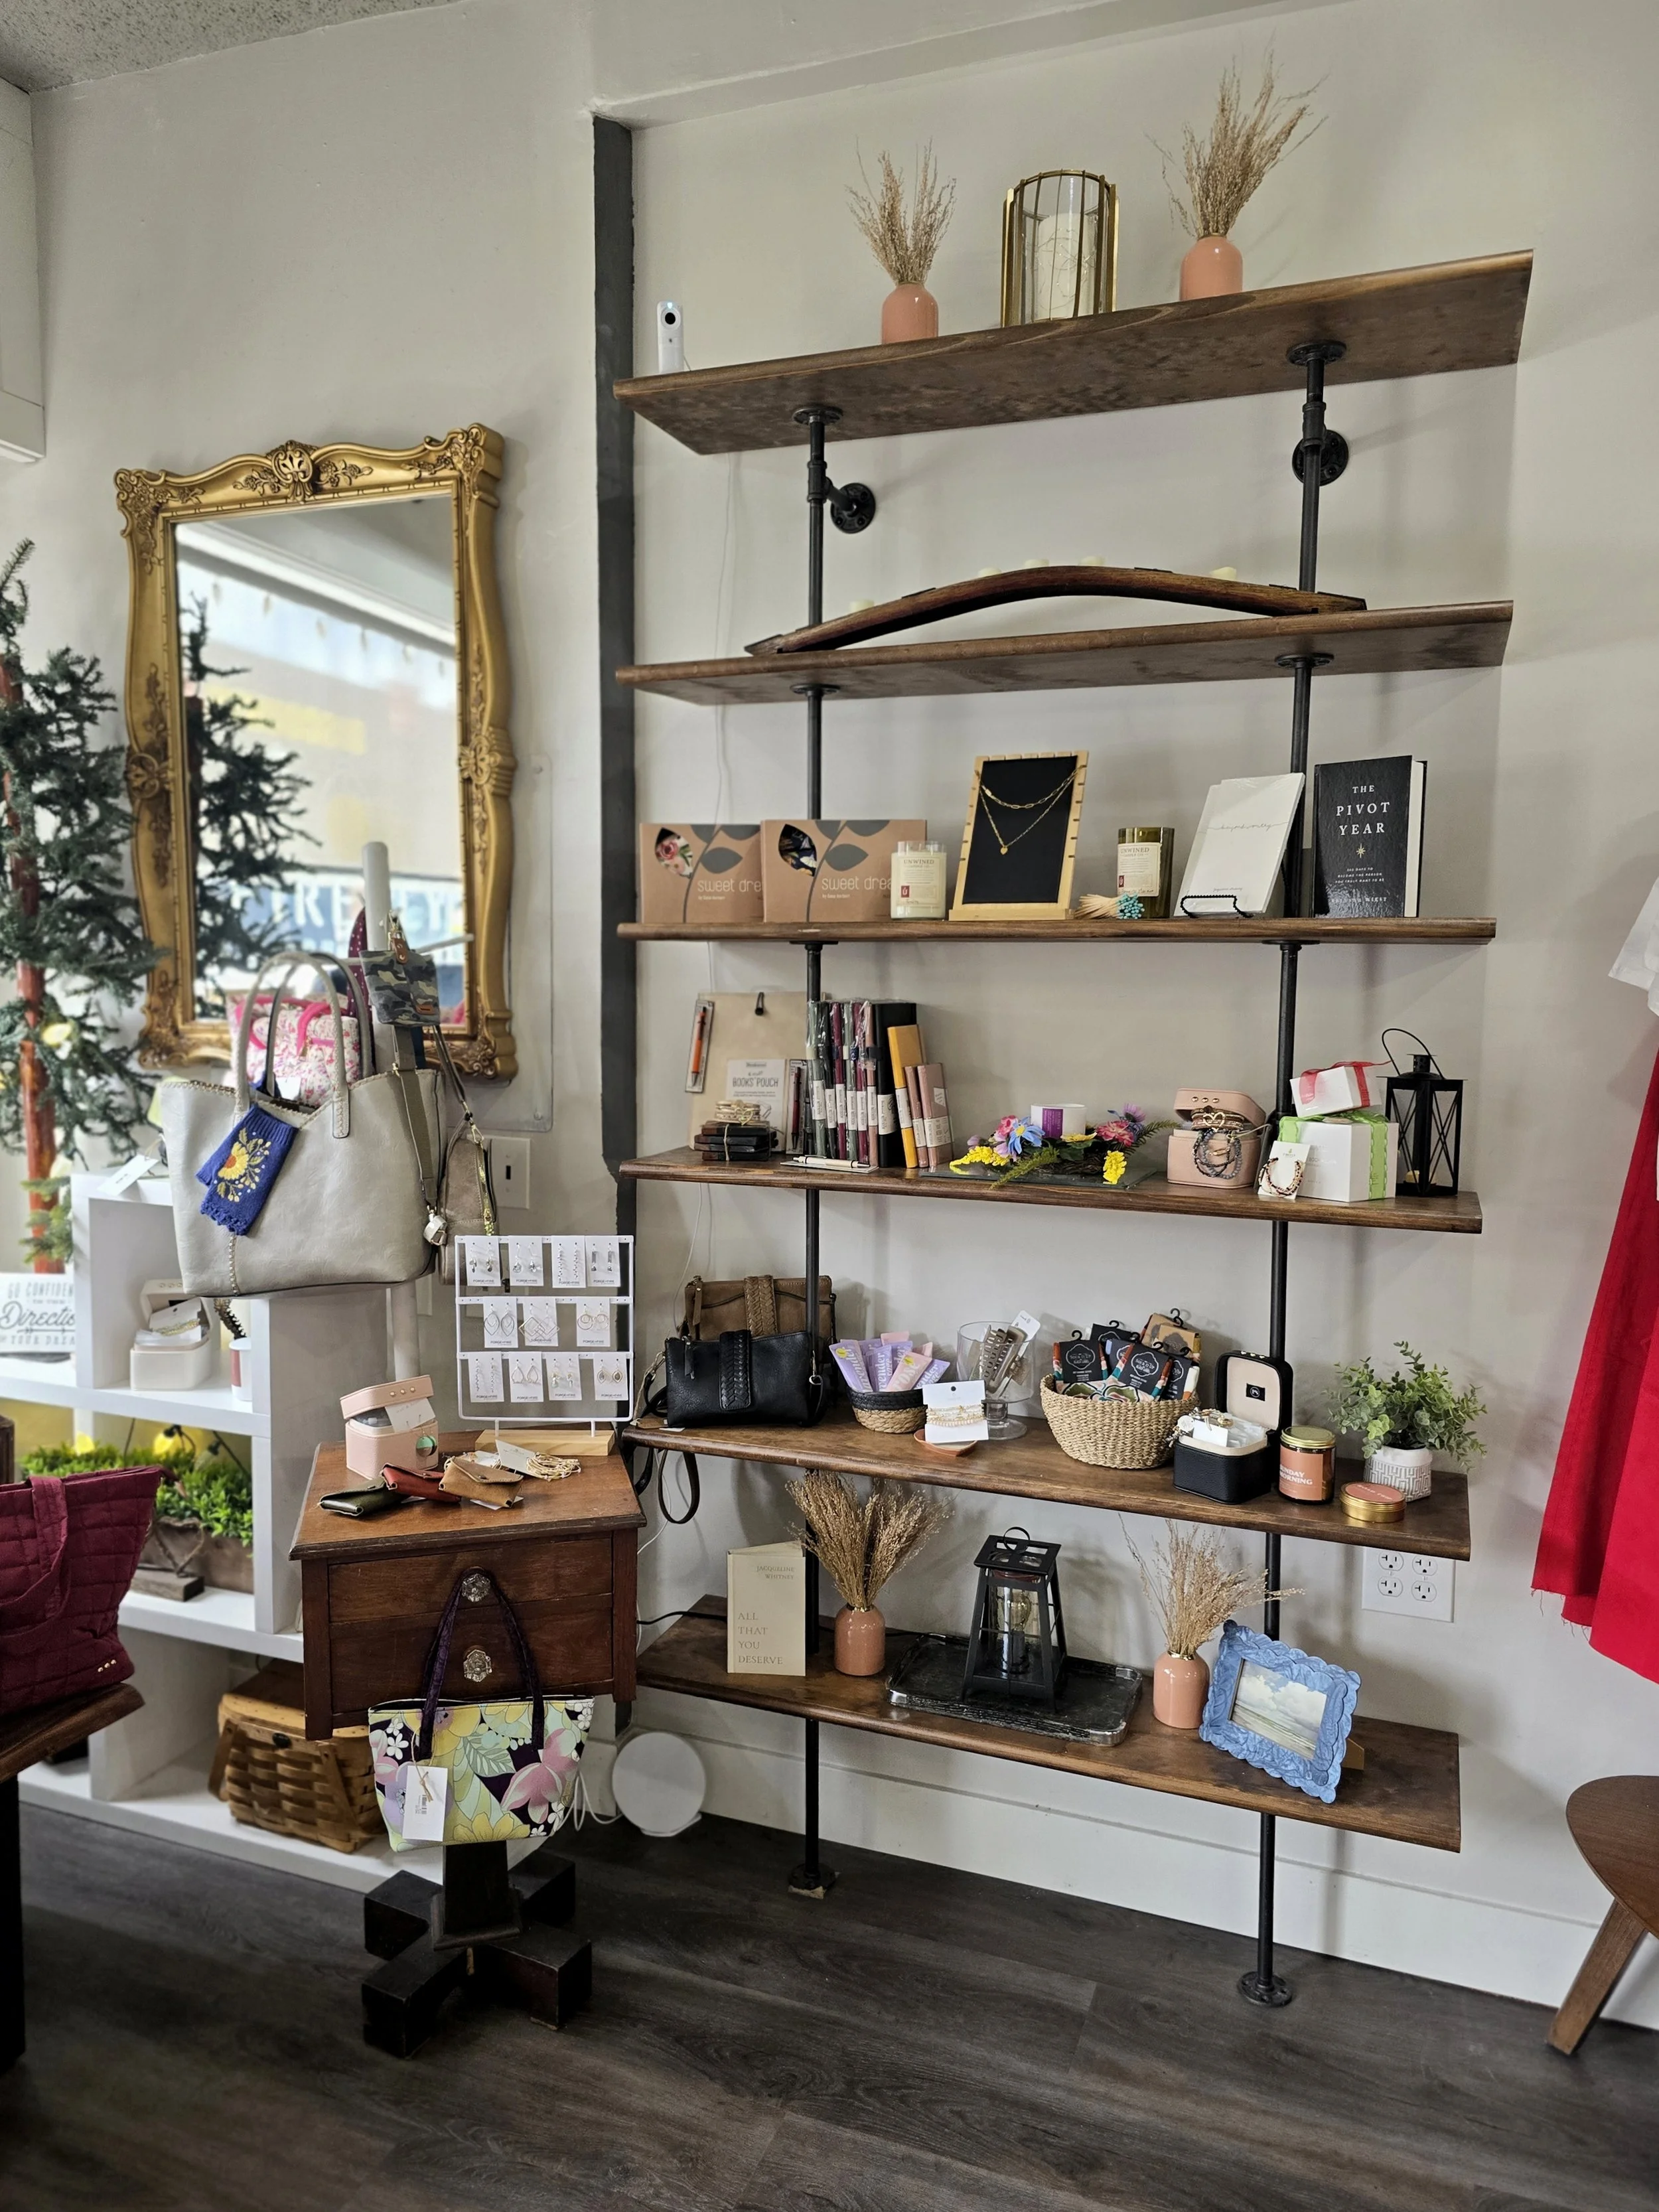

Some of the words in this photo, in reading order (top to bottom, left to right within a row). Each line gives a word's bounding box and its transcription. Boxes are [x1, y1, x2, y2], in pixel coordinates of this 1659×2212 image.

[1352, 785, 1375, 794] THE
[1336, 802, 1390, 816] PIVOT
[1339, 822, 1385, 836] YEAR
[697, 879, 735, 892] sweet
[822, 876, 859, 890] sweet
[757, 1077, 779, 1087] POUCH
[1280, 1464, 1305, 1478] UNDAY
[738, 1641, 760, 1650] YOU
[738, 1655, 783, 1664] DESERVE
